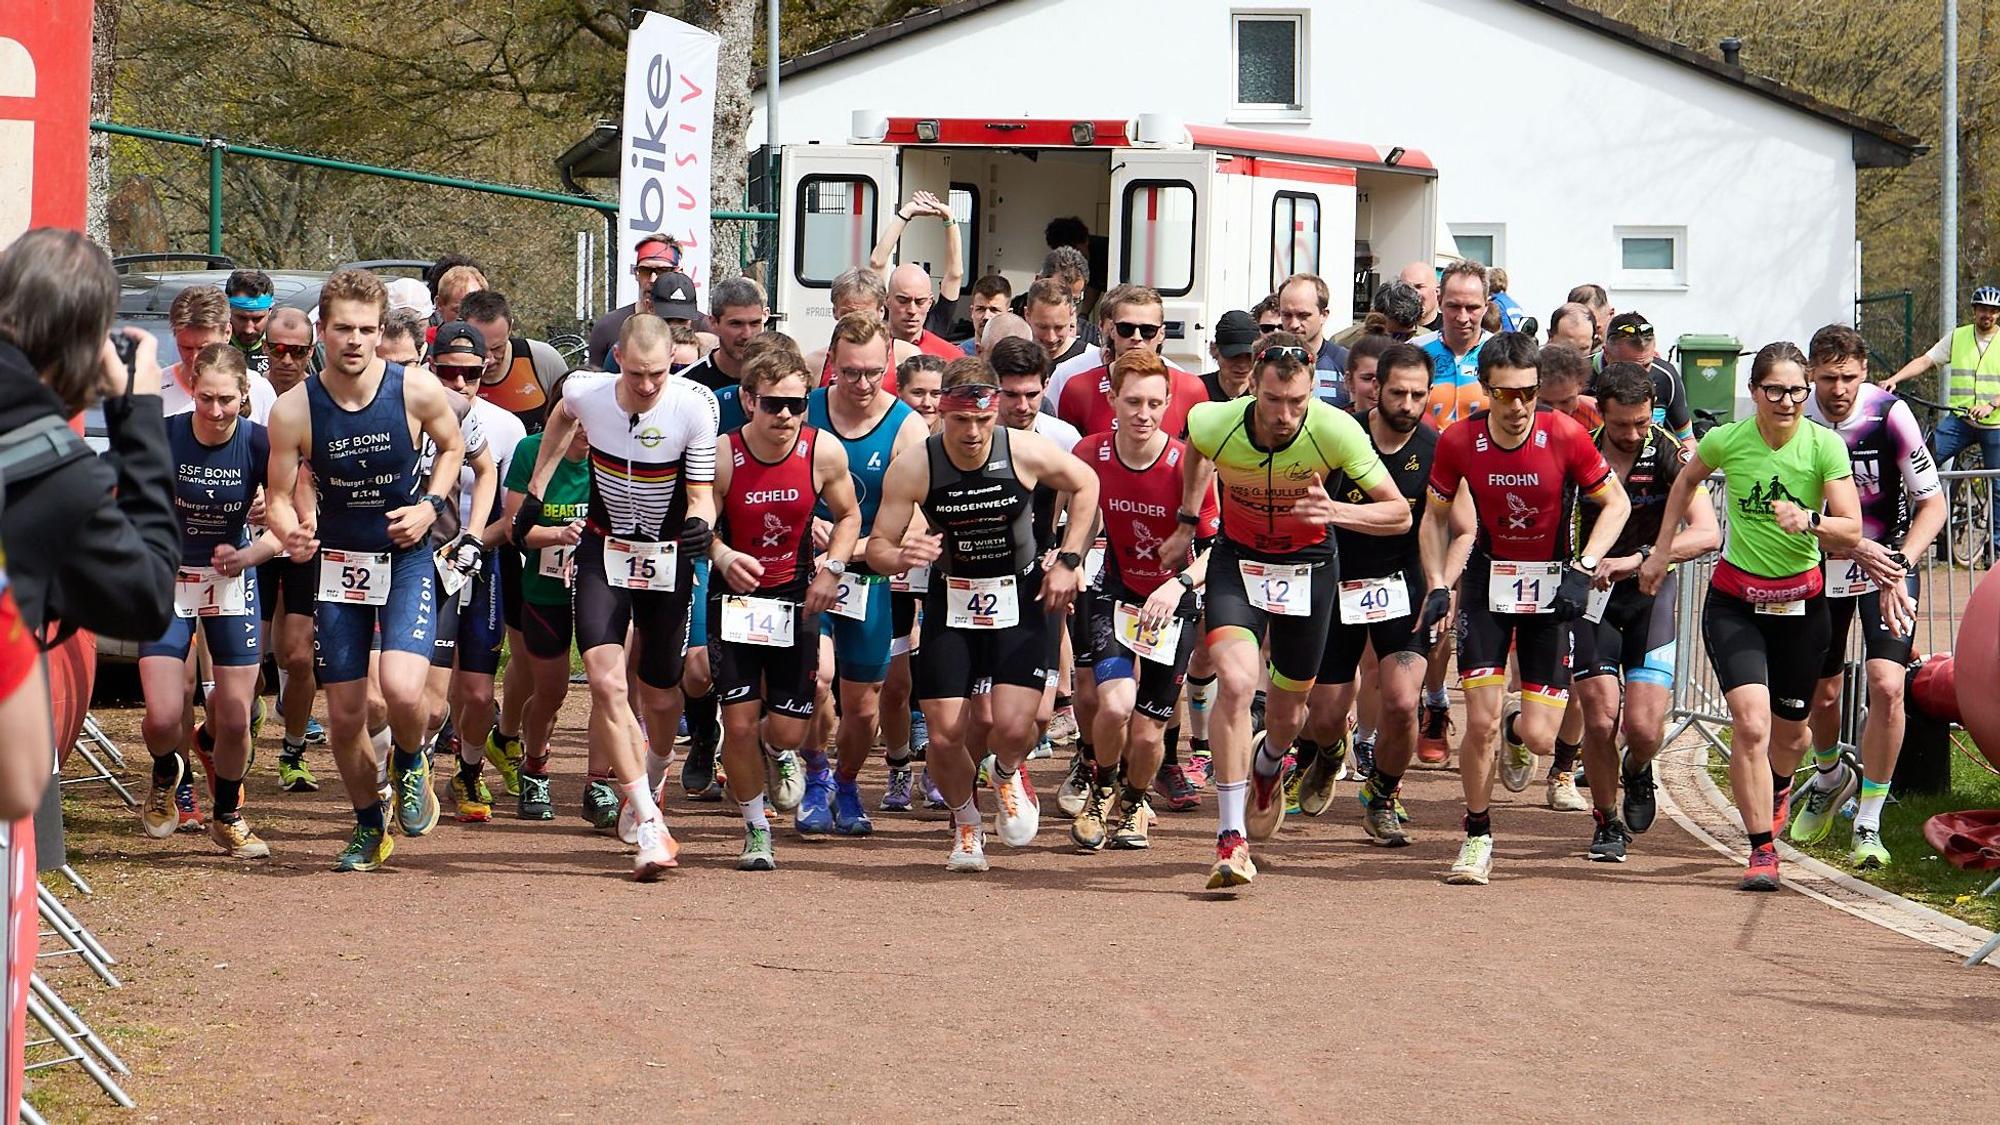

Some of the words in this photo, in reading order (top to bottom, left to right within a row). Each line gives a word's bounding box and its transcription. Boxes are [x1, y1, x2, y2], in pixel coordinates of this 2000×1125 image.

[630, 54, 671, 232] bike
[943, 156, 950, 166] 17
[328, 438, 350, 452] SSF
[352, 432, 391, 447] BONN
[328, 448, 369, 460] TRIATHLON
[370, 444, 391, 453] TEAM
[178, 475, 219, 486] TRIATHLON
[221, 479, 242, 487] TEAM
[179, 464, 202, 475] SSF
[204, 468, 241, 479] BONN
[1488, 473, 1539, 486] FROHN
[174, 496, 210, 511] itburger
[744, 488, 799, 505] SCHELD
[936, 495, 1018, 513] MORGENWECK
[1109, 498, 1166, 518] HOLDER
[974, 537, 1006, 547] WIRTH
[341, 566, 371, 590] 52
[625, 556, 656, 579] 15
[204, 584, 215, 605] 1
[837, 584, 850, 605] 2
[1261, 579, 1290, 602] 12
[1360, 587, 1389, 609] 40
[1513, 579, 1540, 601] 11
[245, 579, 257, 648] RYZON
[412, 576, 432, 640] RYZON
[967, 593, 998, 616] 42
[744, 612, 774, 634] 14
